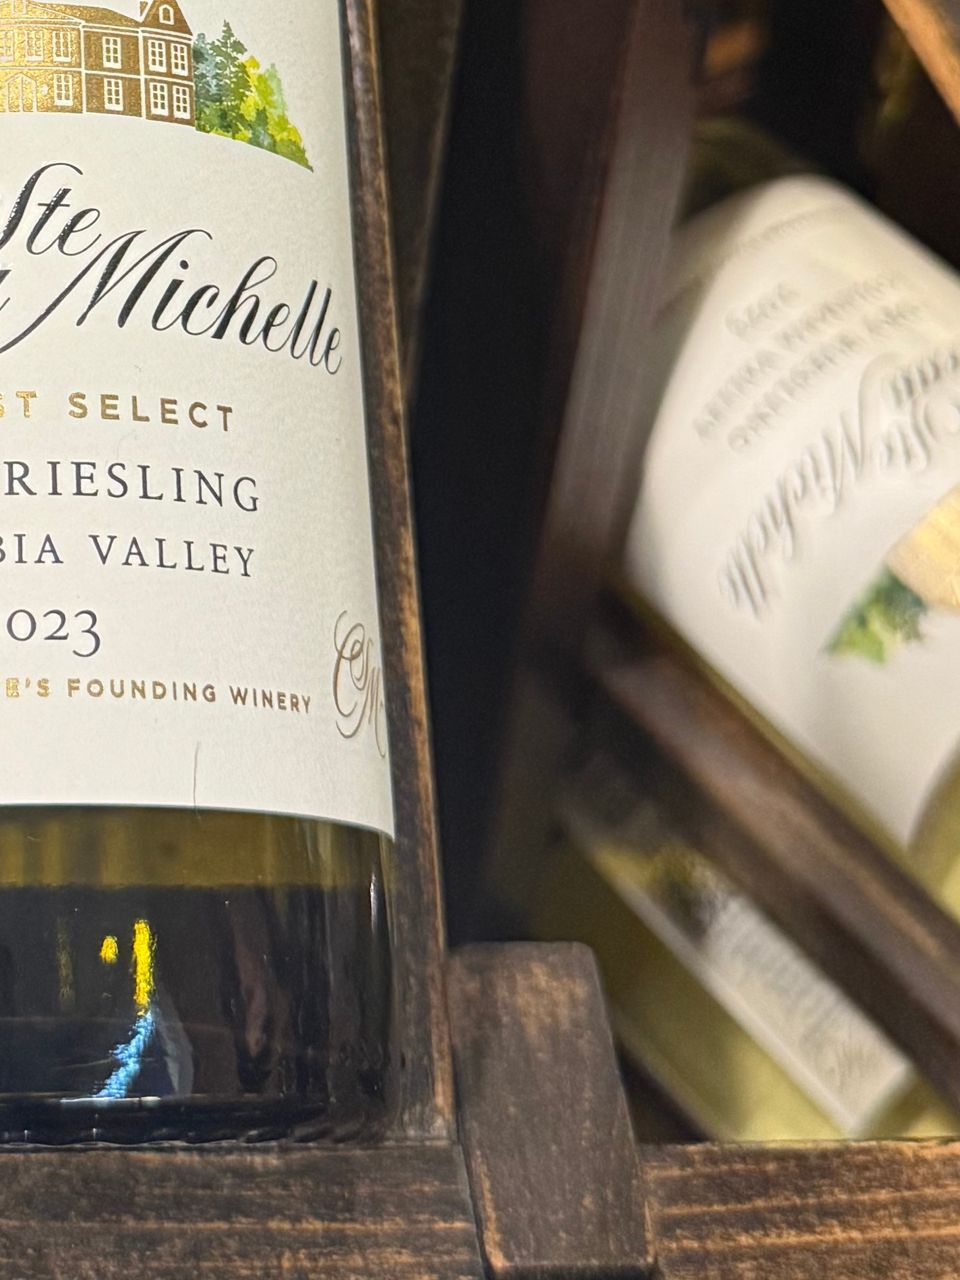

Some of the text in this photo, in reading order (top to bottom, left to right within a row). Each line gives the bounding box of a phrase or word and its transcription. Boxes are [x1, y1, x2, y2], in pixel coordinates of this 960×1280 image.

[69, 391, 235, 433] SELECT
[3, 460, 261, 513] RIESLING
[88, 534, 256, 578] VALLEY
[67, 677, 218, 703] FOUNDING
[229, 685, 312, 715] WINERY
